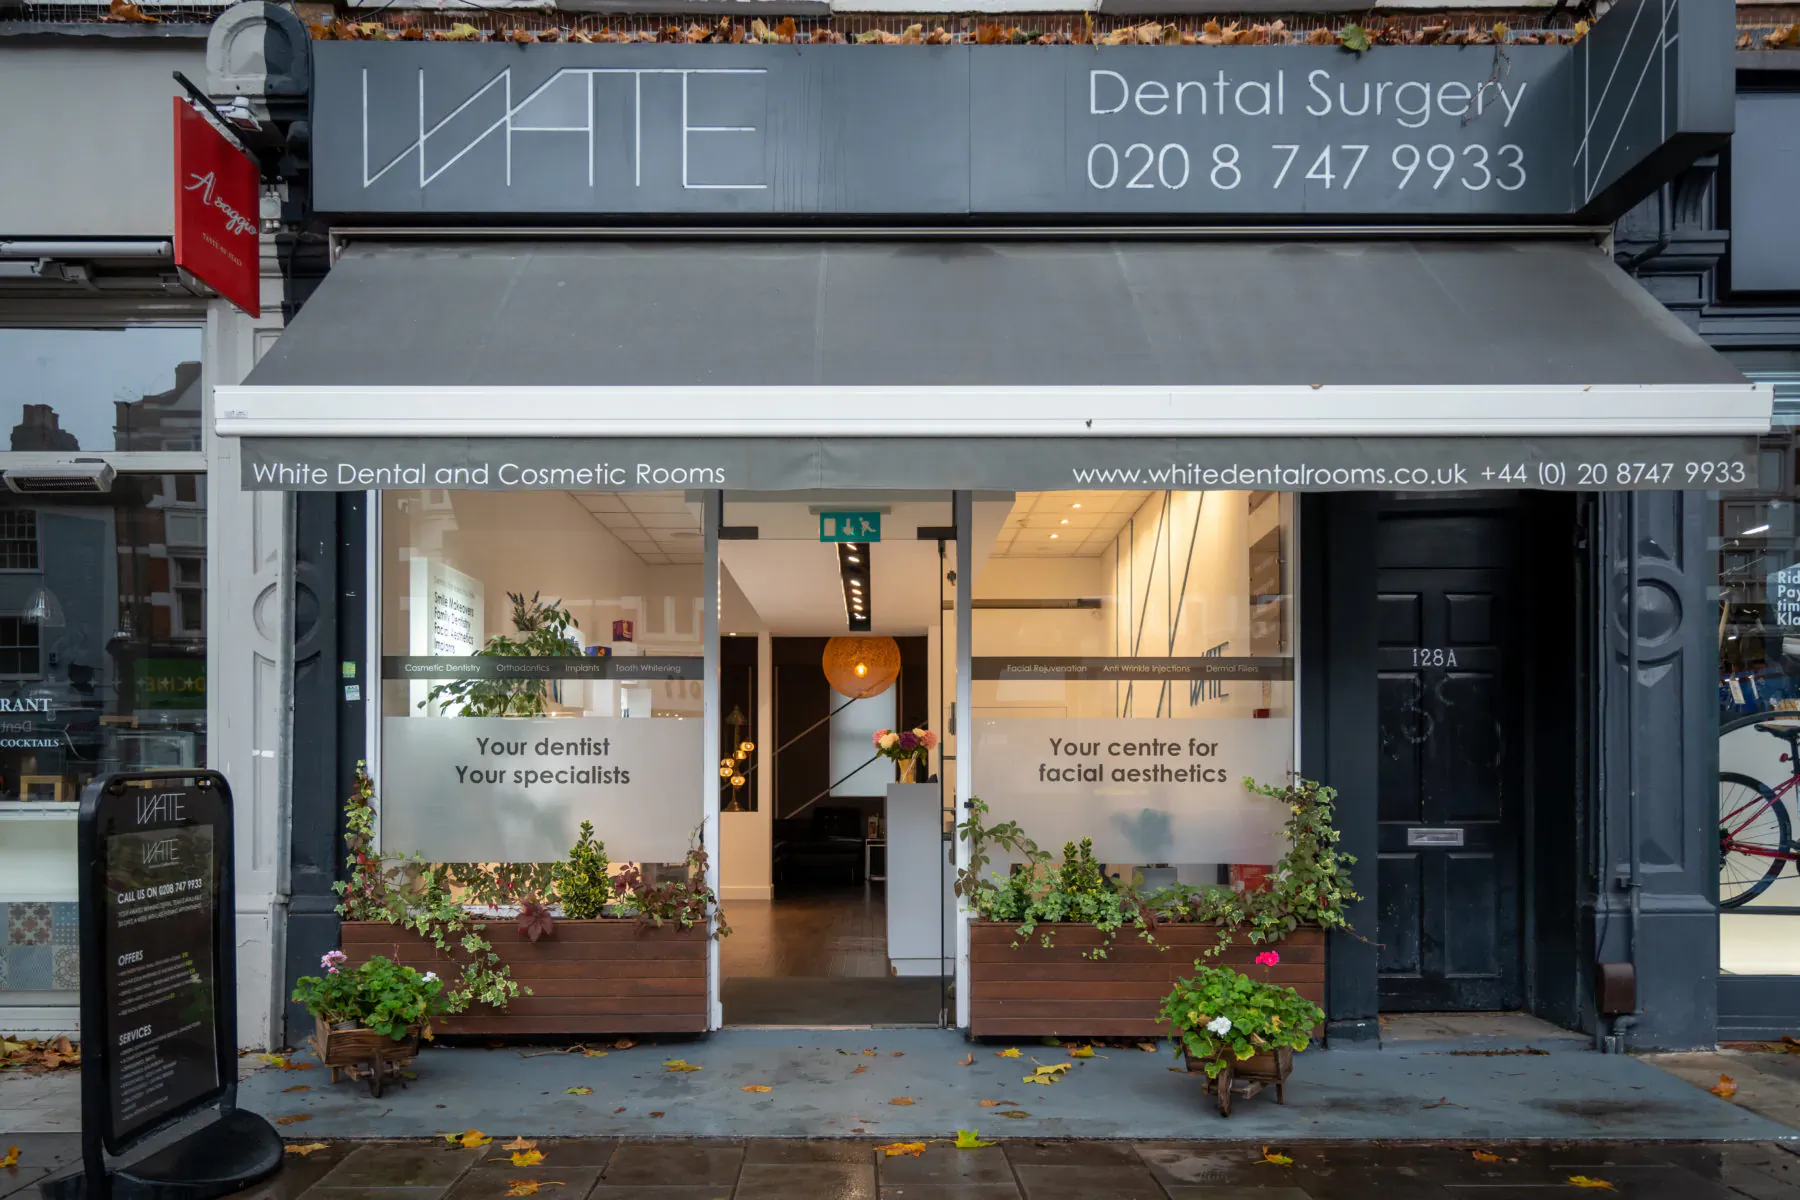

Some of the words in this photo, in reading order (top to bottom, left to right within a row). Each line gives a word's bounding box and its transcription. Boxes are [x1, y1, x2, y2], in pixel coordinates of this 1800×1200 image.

[1090, 69, 1284, 116] Dental
[1307, 69, 1526, 128] Surgery
[1087, 143, 1189, 190] 020
[1211, 144, 1242, 190] 8
[1273, 144, 1369, 190] 747
[1391, 144, 1526, 191] 9933
[252, 462, 328, 486] White
[338, 462, 426, 486] Dental
[435, 462, 489, 486] and
[498, 462, 627, 486] Cosmetic
[636, 462, 726, 486] Rooms
[1073, 462, 1467, 486] www.whitedentalrooms.co.uk
[1481, 465, 1527, 484] +44
[1538, 462, 1566, 487] (0)
[1578, 463, 1608, 485] 20
[1616, 462, 1673, 484] 8747
[1685, 461, 1746, 484] 9933
[434, 592, 448, 608] Smile
[1412, 648, 1458, 667] 128A
[405, 663, 443, 673] Cosmetic
[446, 663, 480, 674] Dentistry
[496, 663, 550, 673] Orthodontics
[565, 663, 600, 675] Implants
[616, 663, 639, 673] Tooth
[640, 663, 681, 675] Whitening
[1007, 664, 1031, 673] Facial
[1033, 664, 1087, 675] Rejuvenation
[1103, 664, 1120, 673] Anti
[1121, 664, 1150, 673] Wrinkle
[1152, 664, 1190, 675] Injections
[1206, 664, 1236, 673] Dermal
[1238, 664, 1259, 673] Fillers
[0, 697, 53, 712] RANT
[0, 738, 59, 748] COCKTAILS
[476, 737, 527, 757] Your
[534, 737, 610, 757] dentist
[1049, 738, 1100, 758] Your
[1108, 740, 1182, 758] centre
[1187, 738, 1219, 758] for
[455, 765, 506, 785] Your
[513, 764, 630, 788] specialists
[1039, 763, 1104, 783] facial
[1111, 763, 1227, 783] aesthetics
[117, 891, 135, 904] CALL
[137, 889, 145, 900] US
[147, 886, 158, 898] ON
[175, 881, 187, 892] 747
[118, 949, 144, 966] OFFERS
[119, 1024, 152, 1046] SERVICES
